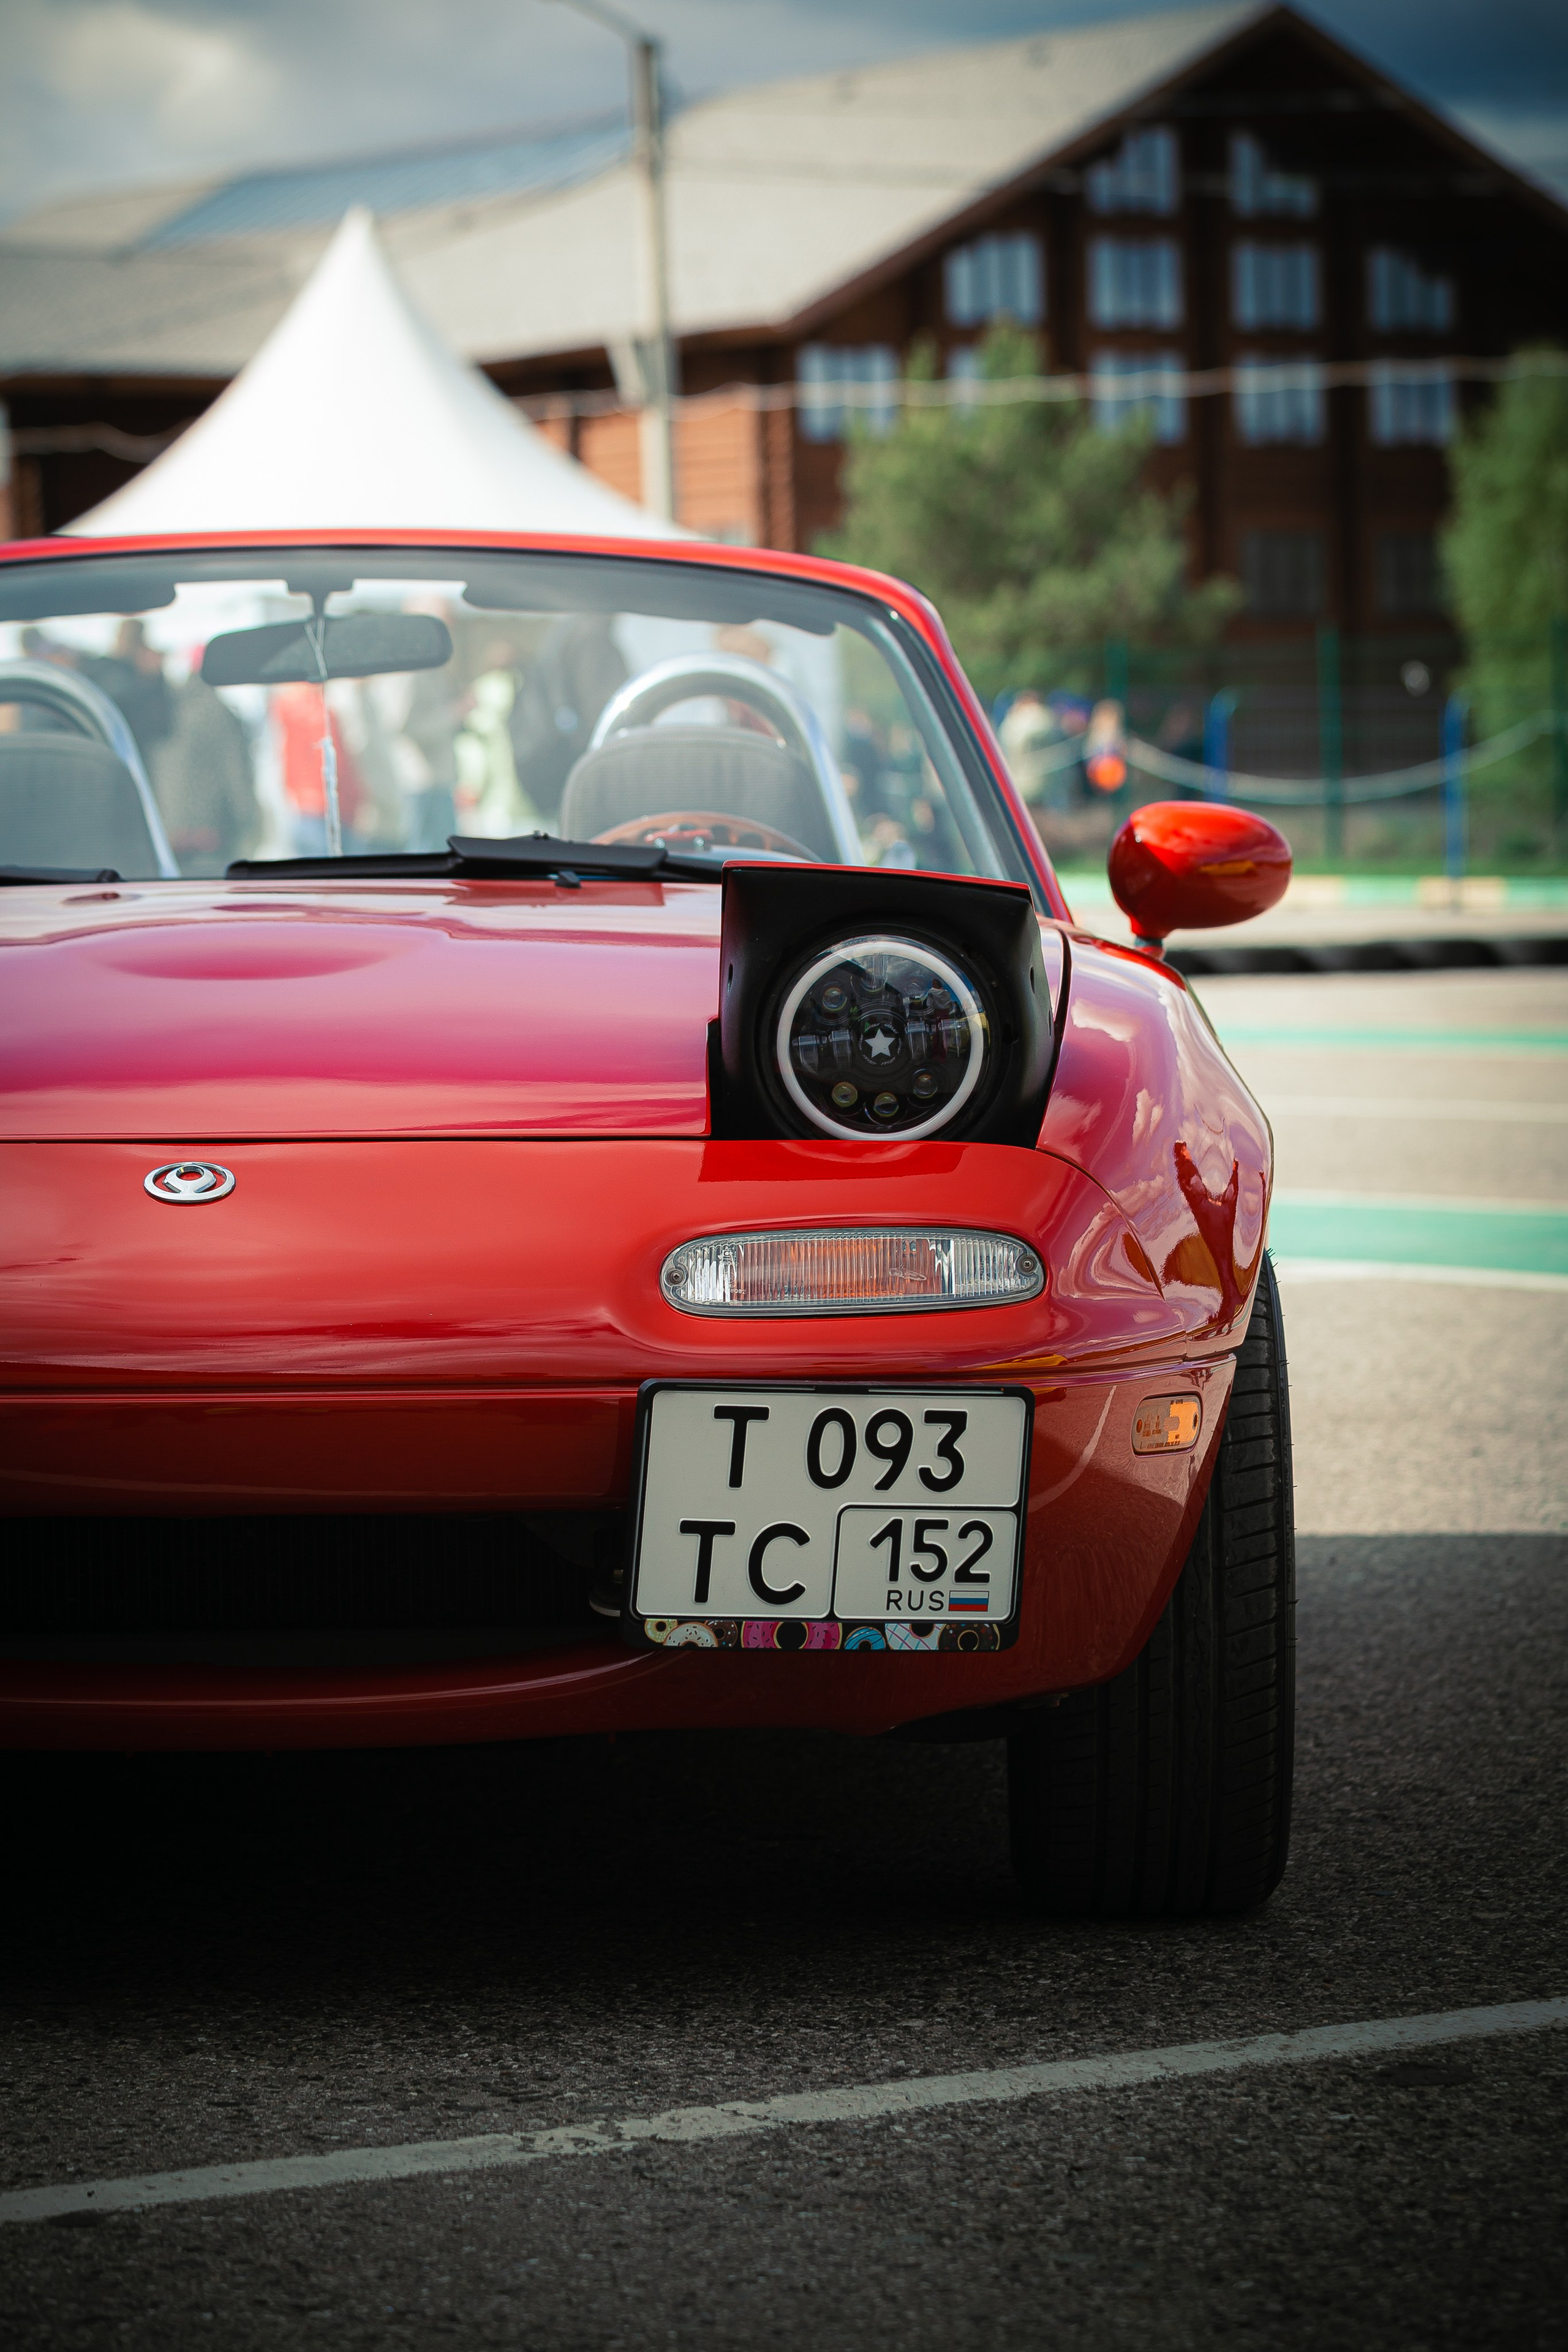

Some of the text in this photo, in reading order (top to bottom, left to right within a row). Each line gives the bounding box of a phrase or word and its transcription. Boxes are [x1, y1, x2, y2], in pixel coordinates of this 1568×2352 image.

[807, 1407, 968, 1493] 093
[869, 1518, 994, 1584] 152
[886, 1589, 944, 1611] RUS
